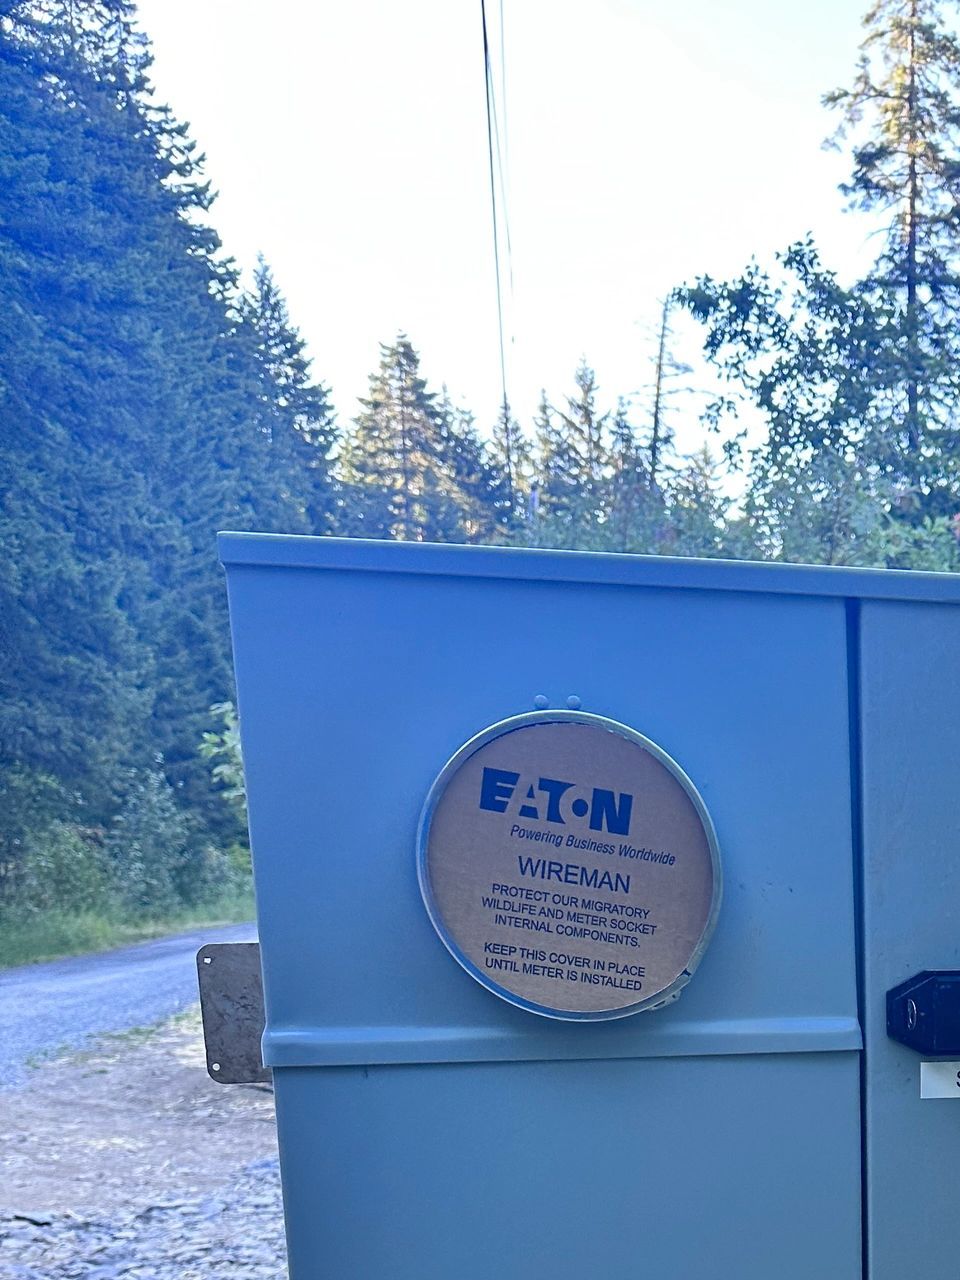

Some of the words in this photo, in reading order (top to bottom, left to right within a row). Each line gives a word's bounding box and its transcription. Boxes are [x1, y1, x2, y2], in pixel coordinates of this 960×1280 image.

[480, 767, 632, 836] EATON
[511, 825, 564, 847] Powering
[566, 836, 616, 855] Business
[619, 844, 676, 866] Worldwide
[518, 856, 631, 893] WIREMAN
[482, 897, 536, 915] WILDLIFE
[539, 908, 563, 920] AND
[567, 912, 607, 927] METER
[610, 919, 657, 935] SOCKET
[492, 884, 550, 903] PROTECT
[553, 893, 579, 908] OUR
[581, 899, 650, 919] MIGRATORY
[495, 914, 553, 933] INTERNAL
[484, 942, 516, 957] KEEP
[520, 948, 546, 961] THIS
[549, 953, 590, 969] COVER
[594, 960, 605, 971] IN
[608, 962, 645, 977] PLACE
[485, 958, 520, 973] UNTIL
[523, 964, 564, 979] METER
[567, 970, 578, 981] IS
[581, 972, 642, 991] INSTALLED
